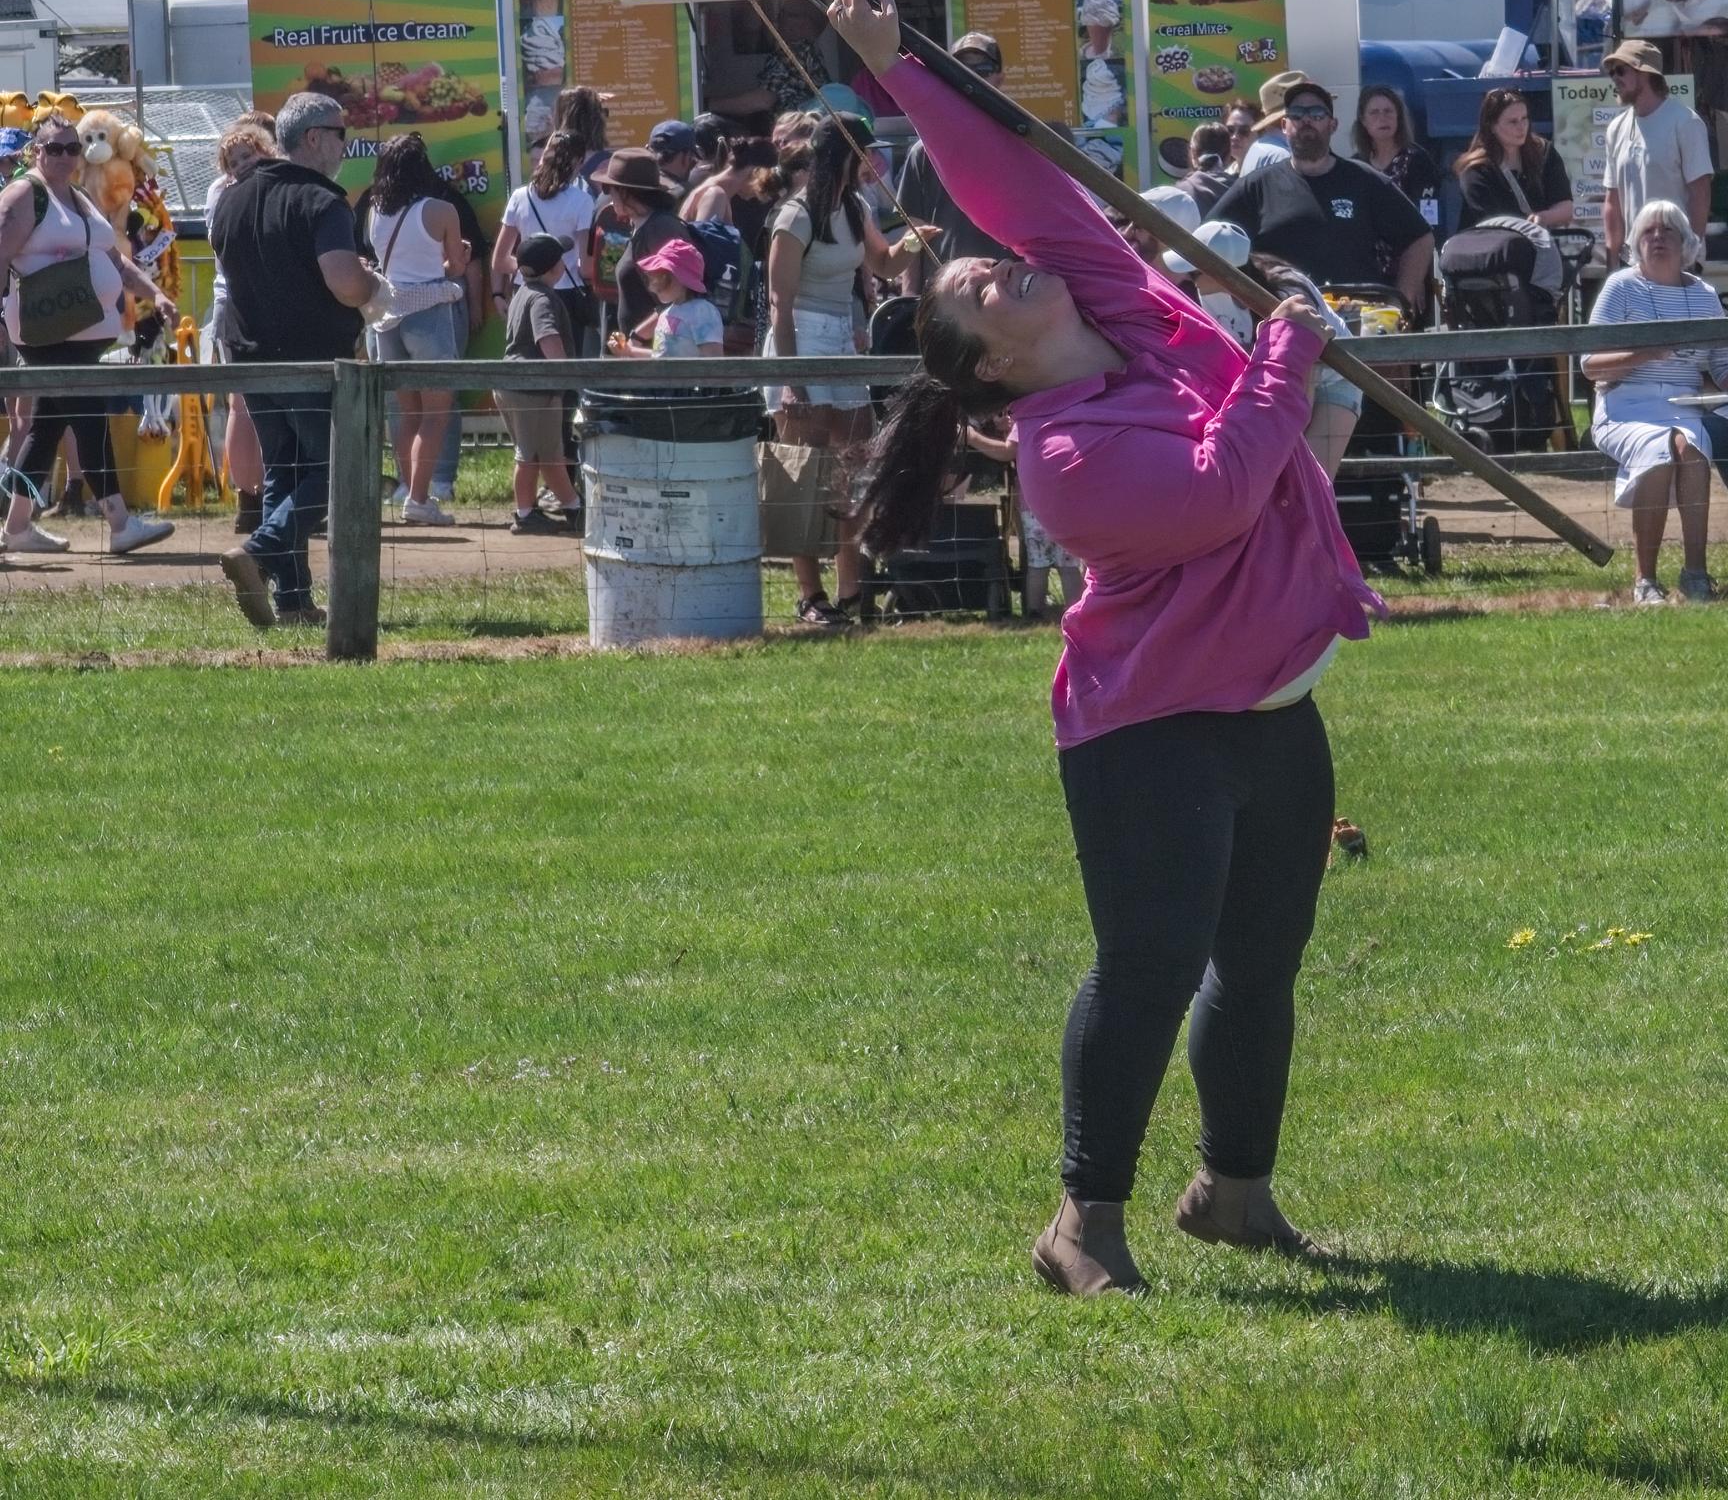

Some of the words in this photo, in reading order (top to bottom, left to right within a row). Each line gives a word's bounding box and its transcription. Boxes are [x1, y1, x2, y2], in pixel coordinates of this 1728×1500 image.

[273, 25, 315, 47] Real
[321, 23, 366, 45] Fruit
[402, 21, 467, 40] Cream
[1158, 24, 1193, 36] Cereal
[1196, 23, 1228, 35] Mixes
[1155, 50, 1190, 67] COCO
[1162, 61, 1187, 75] pops
